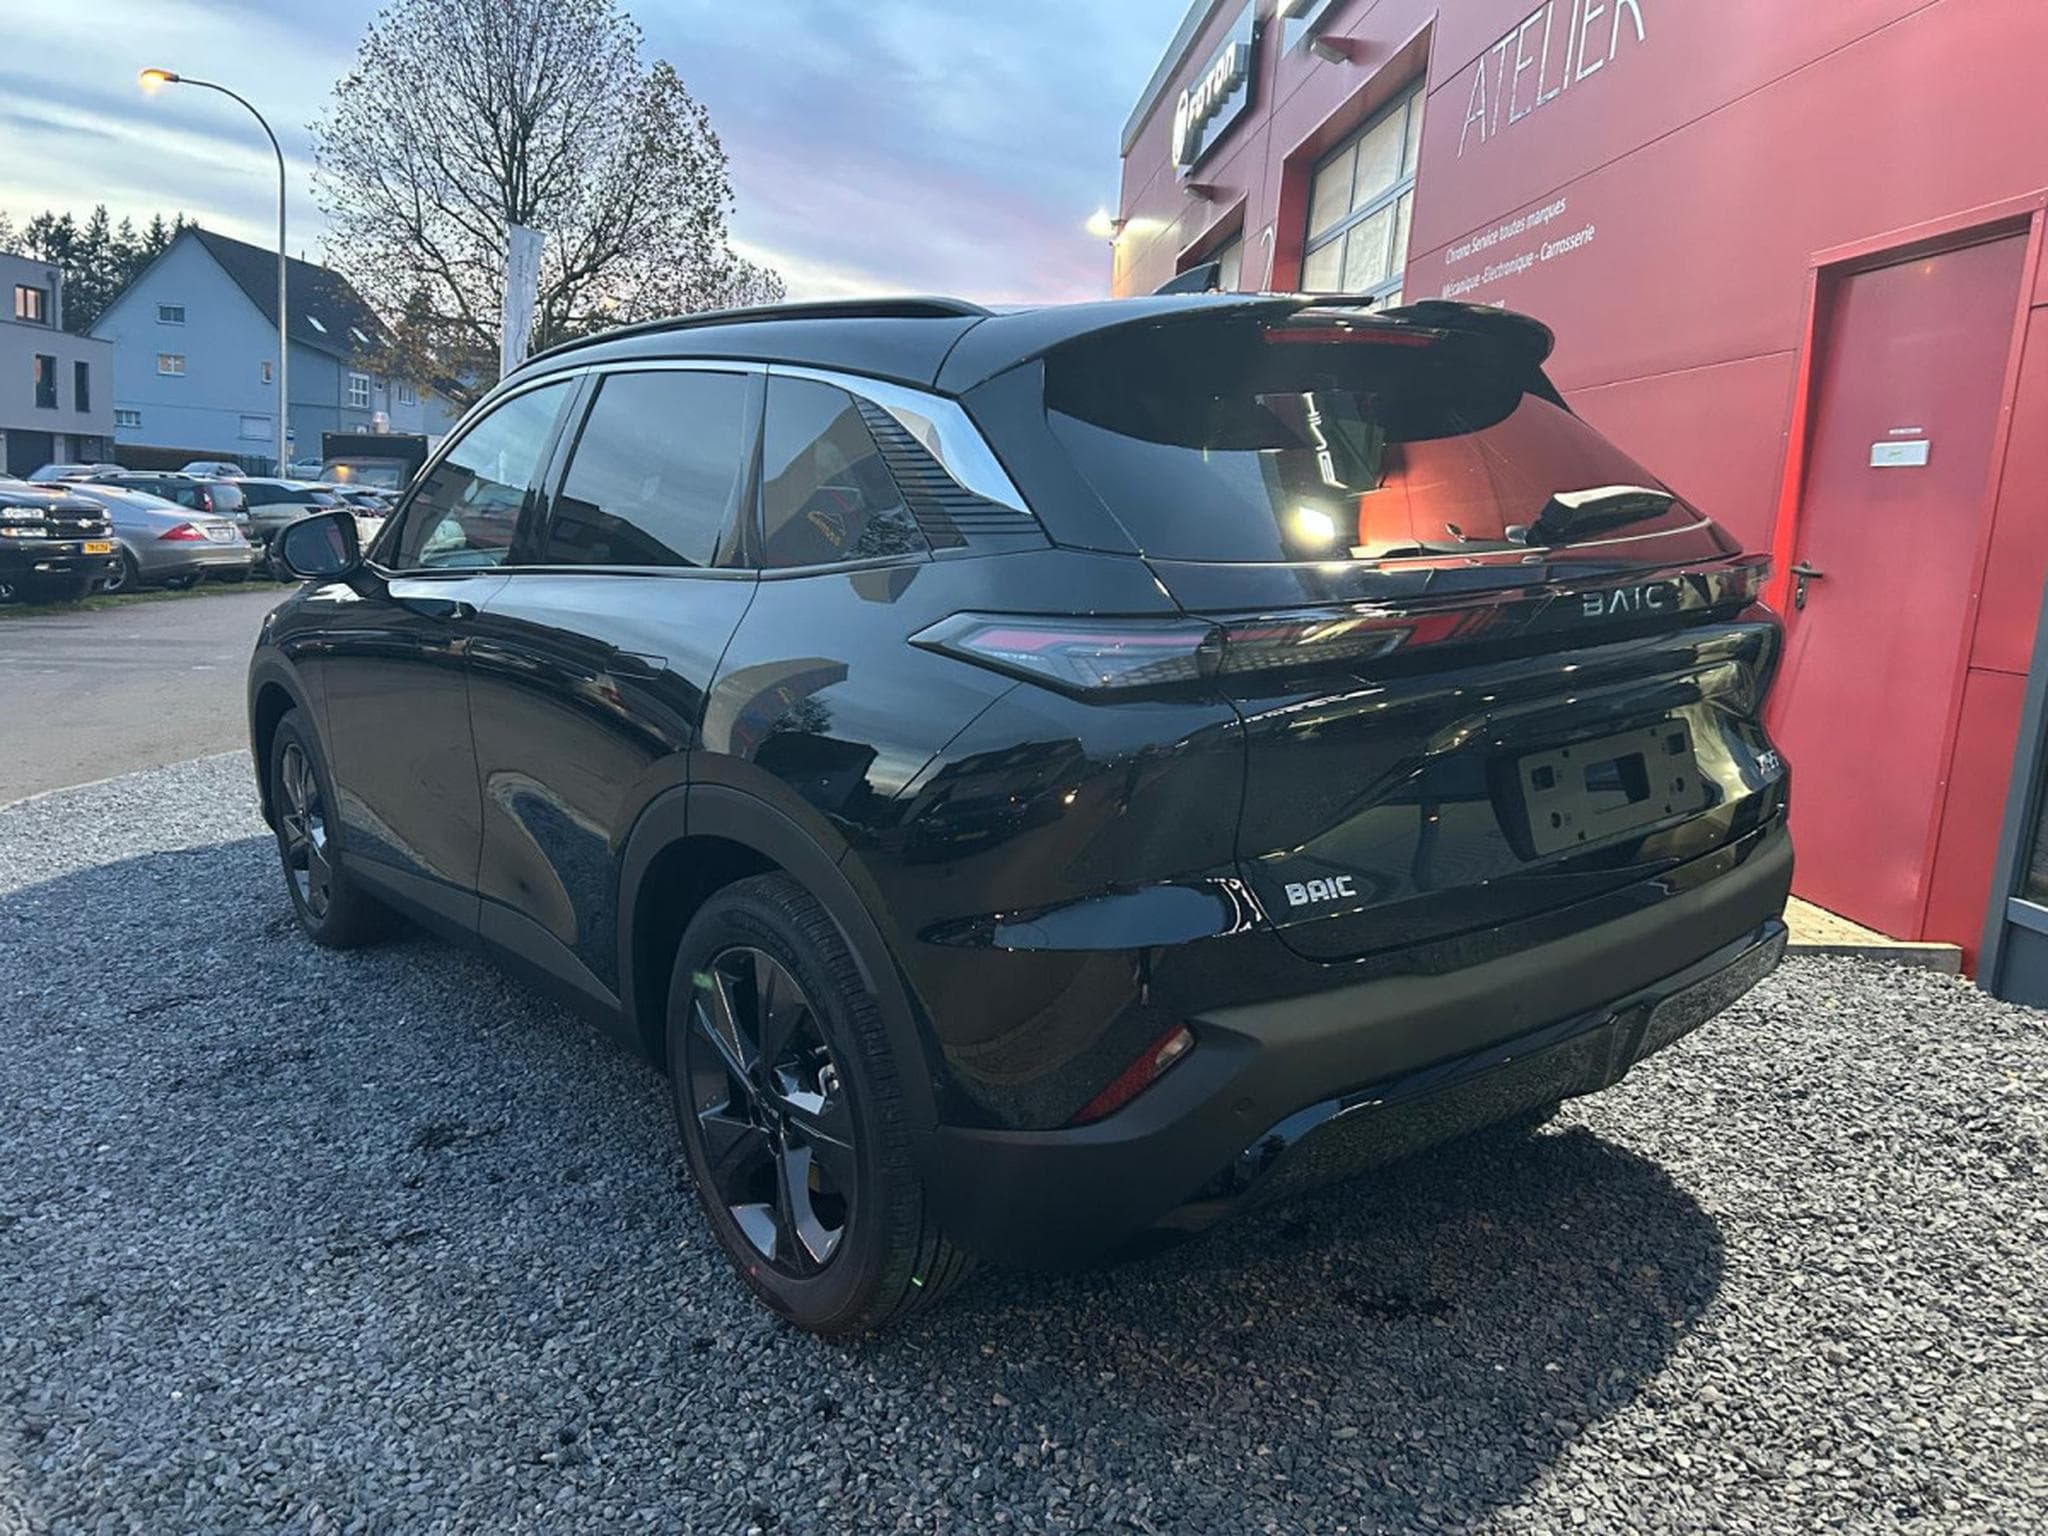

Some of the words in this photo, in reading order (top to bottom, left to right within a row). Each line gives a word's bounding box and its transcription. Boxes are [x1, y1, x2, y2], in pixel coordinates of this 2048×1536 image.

[1471, 230, 1499, 253] Service
[1500, 217, 1526, 241] toutes
[1526, 197, 1567, 228] marques
[1540, 223, 1596, 261] Carrosserie
[1582, 584, 1665, 617] BAIC
[1284, 875, 1357, 906] BAIC
